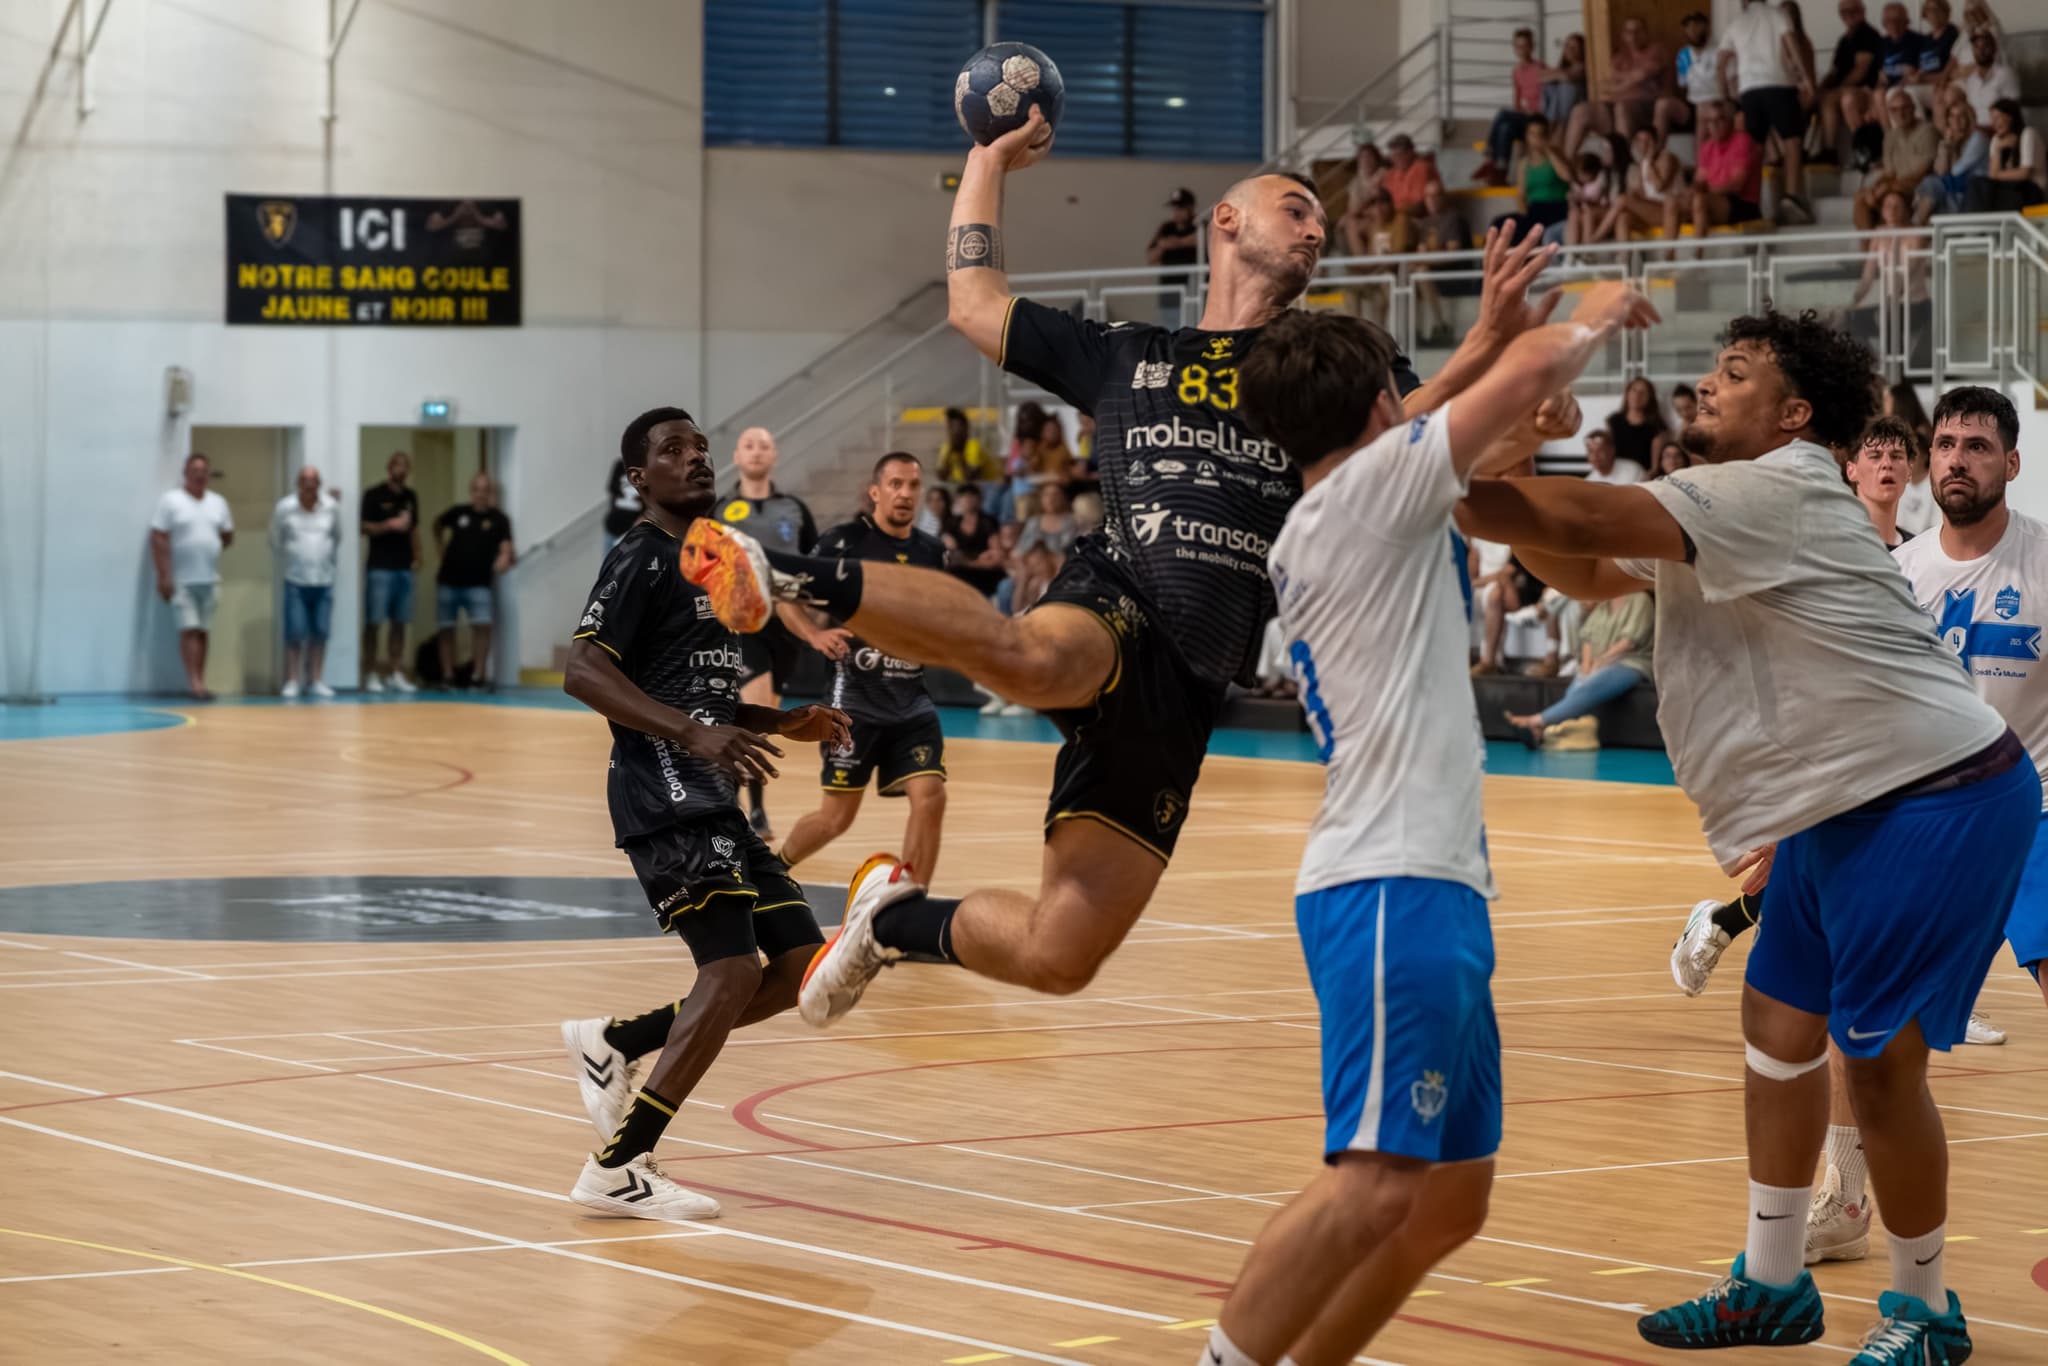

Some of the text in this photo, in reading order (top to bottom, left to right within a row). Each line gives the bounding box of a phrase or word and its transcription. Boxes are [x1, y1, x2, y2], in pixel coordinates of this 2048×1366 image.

[339, 208, 406, 250] ICI
[238, 264, 509, 291] NOTRE SANG COULE
[261, 296, 350, 319] JAUNE
[356, 302, 384, 321] ET
[391, 297, 454, 319] NOIR
[1178, 364, 1240, 410] 83
[1176, 546, 1197, 560] the
[654, 737, 687, 802] Coopazu
